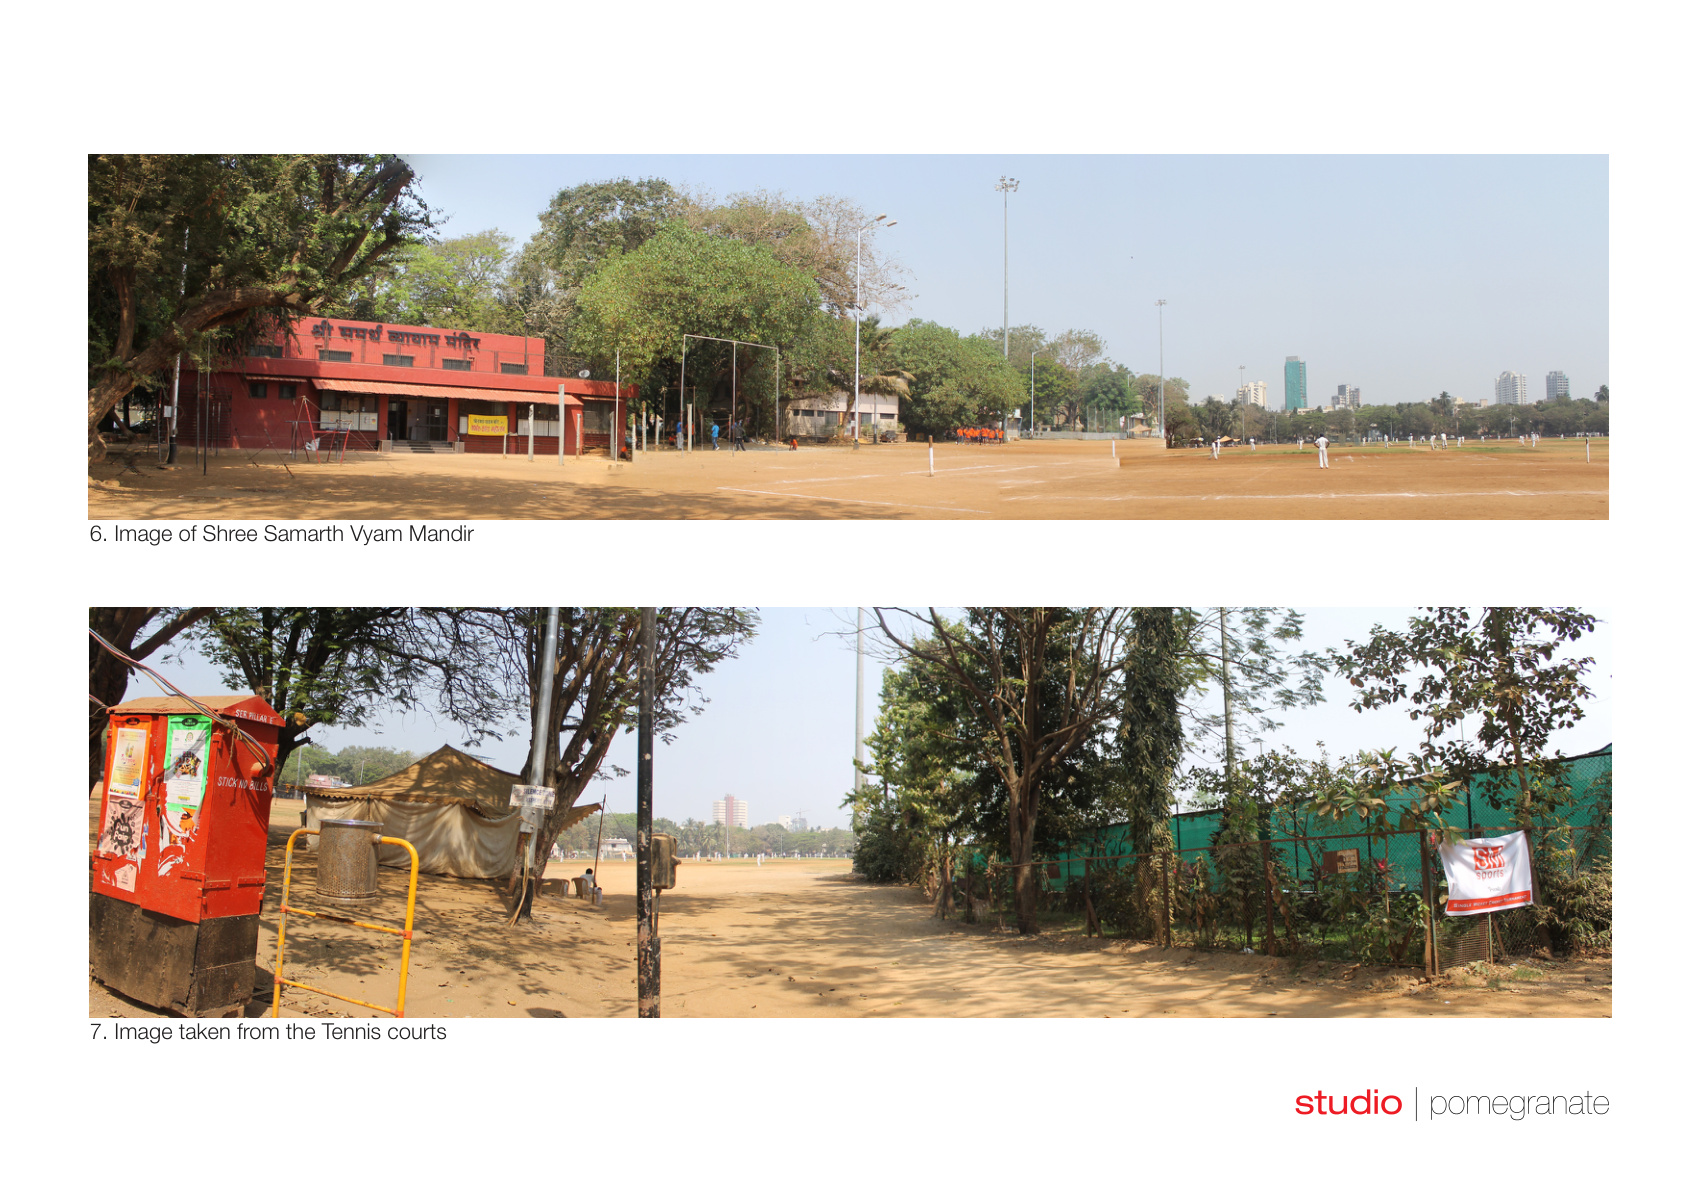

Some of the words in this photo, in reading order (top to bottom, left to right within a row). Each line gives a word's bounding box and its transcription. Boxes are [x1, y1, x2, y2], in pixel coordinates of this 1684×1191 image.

[312, 319, 333, 337] श्री
[338, 324, 383, 342] समर्थ
[387, 329, 441, 346] व्यायाम
[444, 331, 481, 350] मंदिर
[248, 712, 268, 723] PILLAR
[217, 776, 239, 788] STICK
[238, 780, 248, 788] NO
[249, 781, 268, 792] BILLS
[1475, 846, 1505, 870] SM
[1476, 869, 1504, 881] sports
